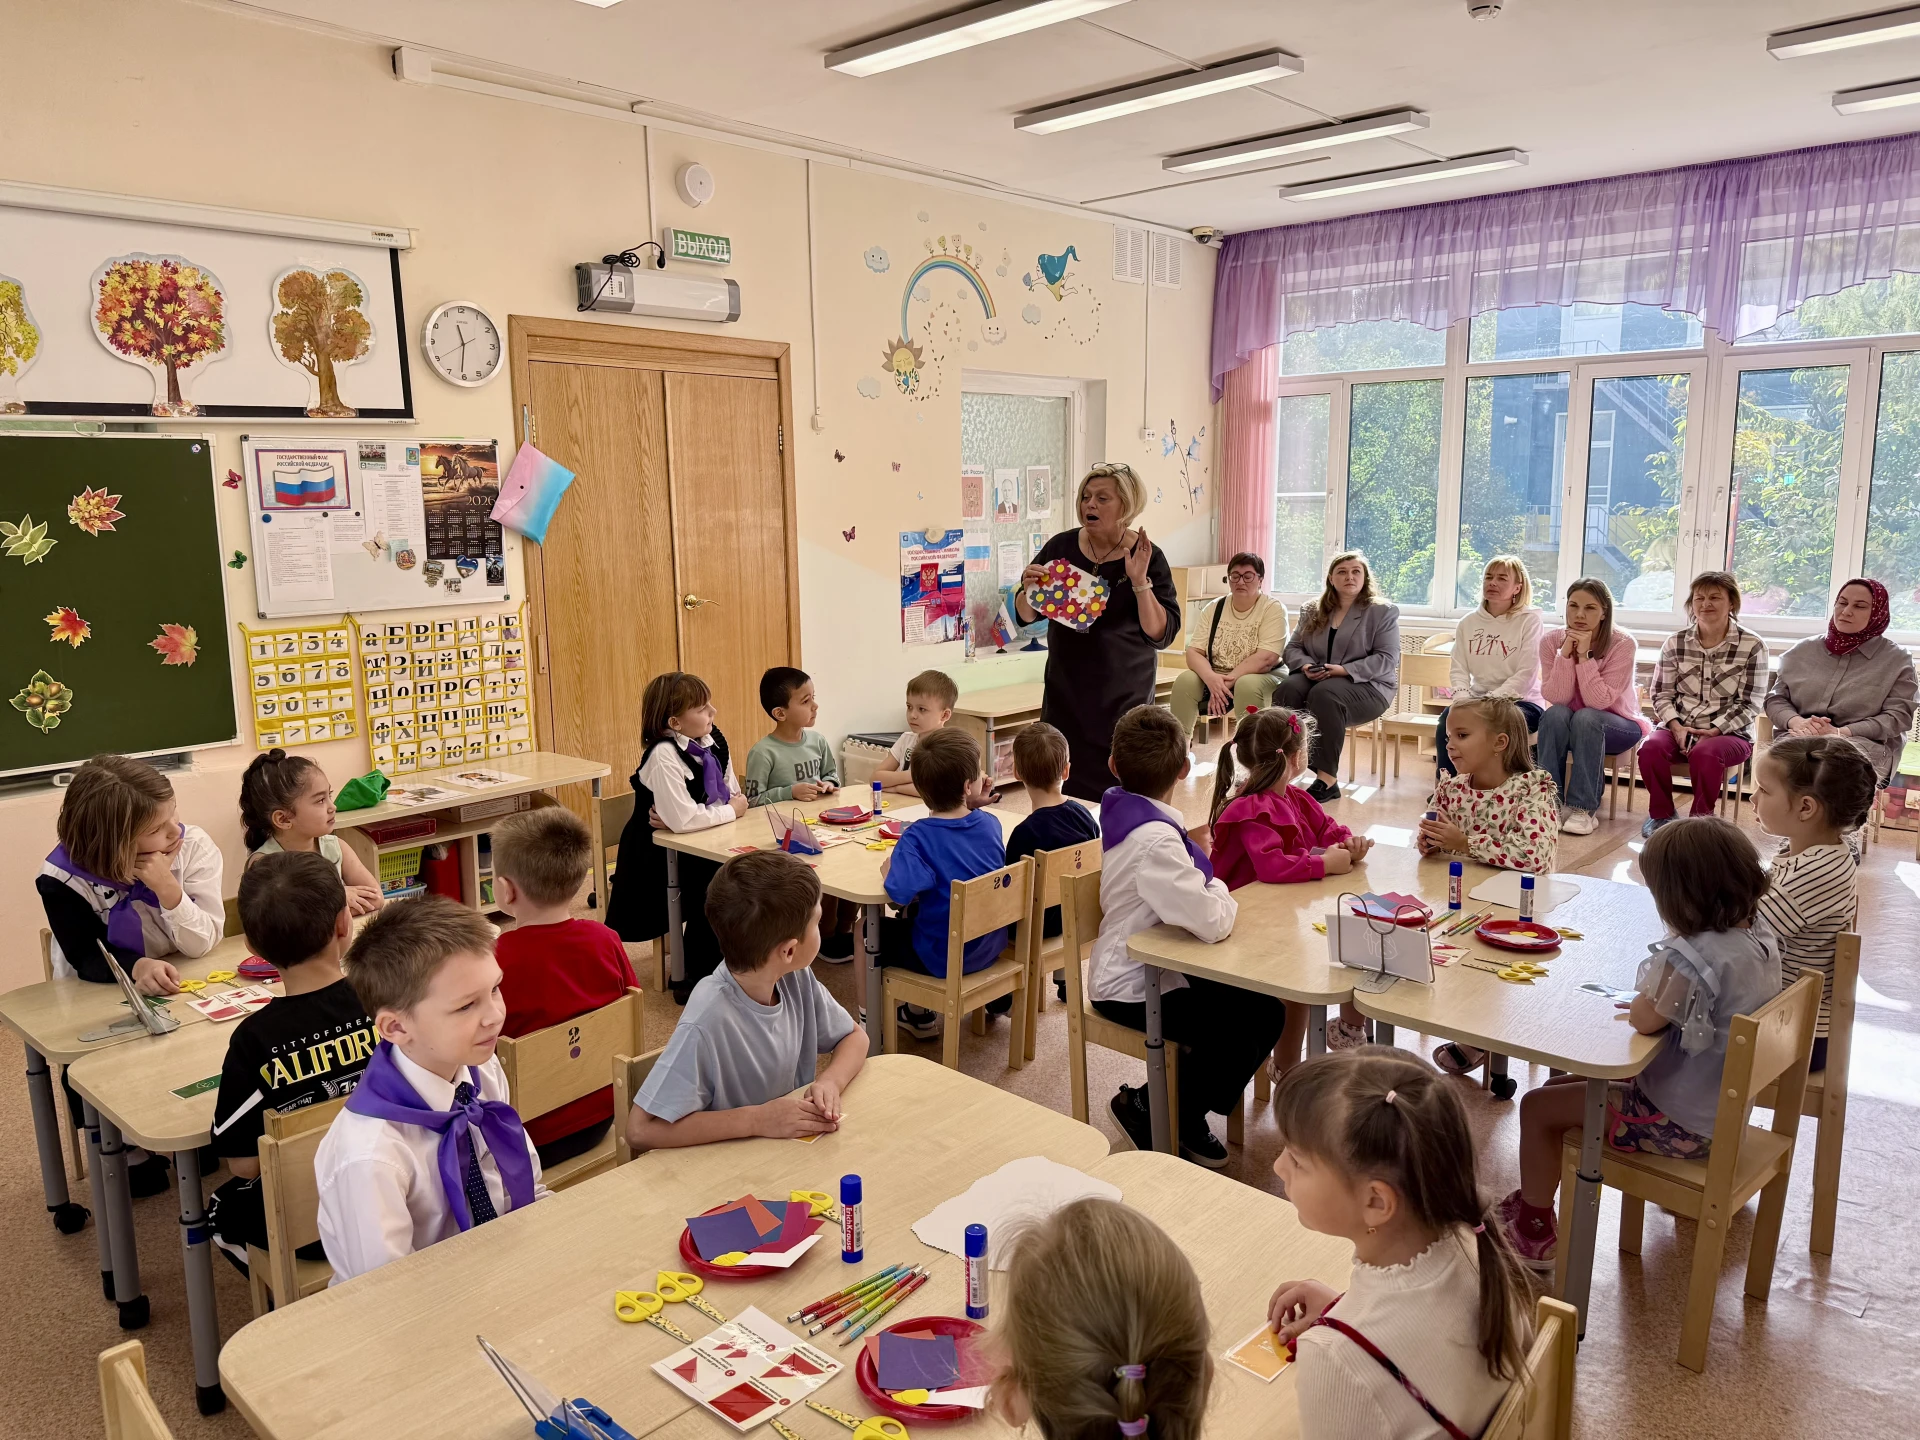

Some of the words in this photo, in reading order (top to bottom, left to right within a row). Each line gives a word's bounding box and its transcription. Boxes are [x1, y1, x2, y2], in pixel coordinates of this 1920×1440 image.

[677, 233, 729, 261] ВЫХОД
[484, 326, 491, 334] 2
[489, 343, 496, 351] 3
[461, 373, 468, 381] 6
[475, 370, 482, 378] 5
[465, 495, 496, 506] 2026
[365, 632, 378, 646] а
[388, 626, 404, 645] Б
[413, 624, 429, 643] В
[437, 622, 453, 642] Г
[460, 619, 477, 643] Д
[485, 620, 495, 633] е
[259, 640, 267, 655] 1
[282, 638, 294, 653] 2
[330, 632, 343, 648] 4
[257, 673, 270, 687] 5
[281, 668, 295, 683] 6
[311, 664, 322, 680] 7
[335, 662, 349, 677] 8
[262, 699, 276, 715] 9
[271, 1036, 307, 1053] CITY
[312, 1029, 330, 1040] OF
[297, 1096, 313, 1108] THAT
[846, 1207, 854, 1250] ErichKrause
